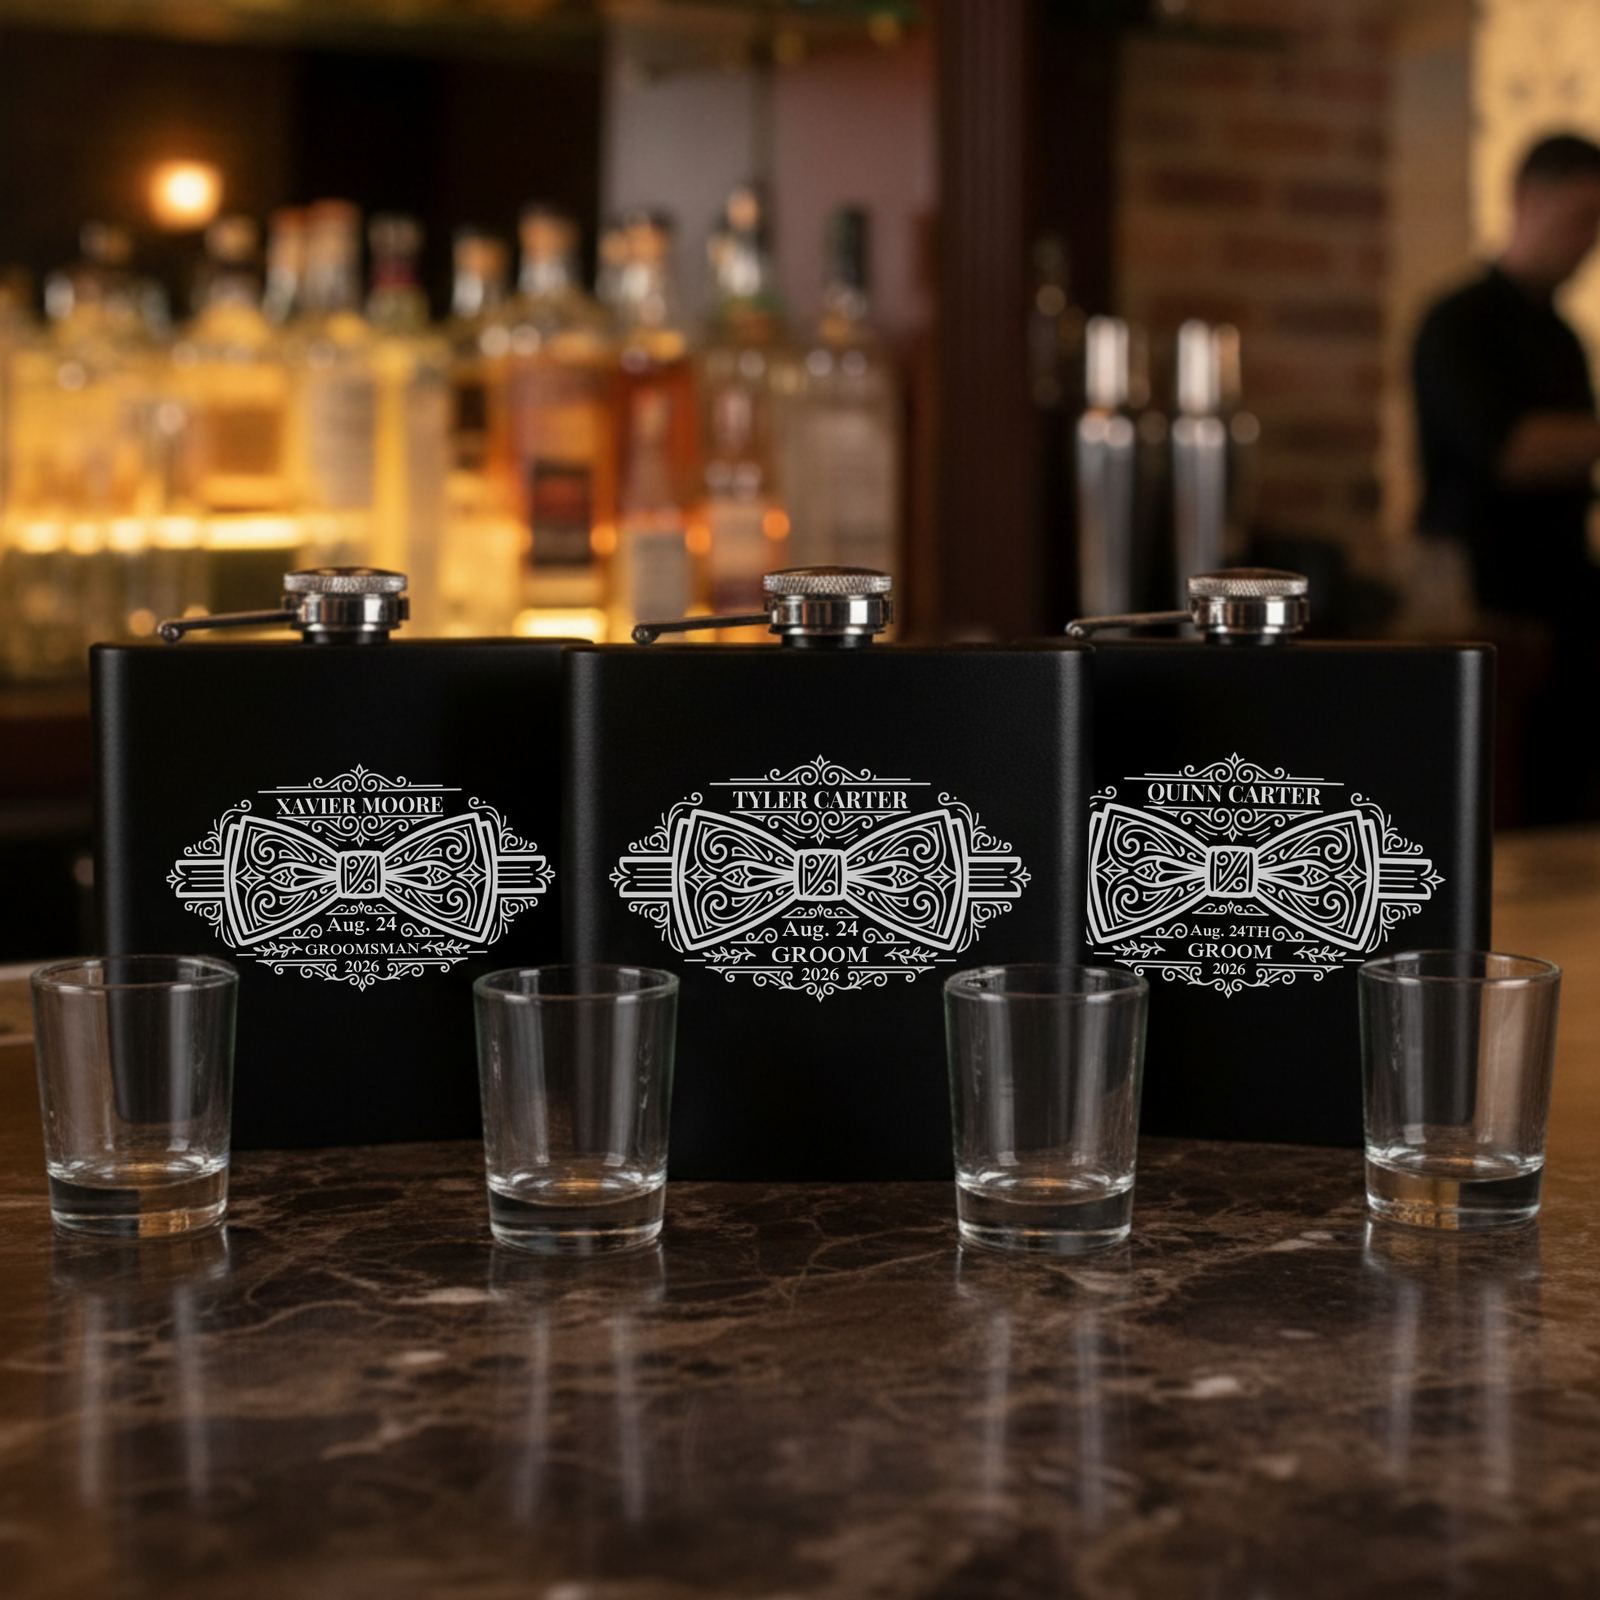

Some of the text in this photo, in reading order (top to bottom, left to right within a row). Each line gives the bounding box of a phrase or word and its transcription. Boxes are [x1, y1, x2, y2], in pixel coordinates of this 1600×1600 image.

[732, 790, 909, 809] TYLER CARTER
[1147, 782, 1321, 806] QUINN CARTER
[276, 795, 444, 815] XAVIER MOORE
[326, 916, 397, 936] Aug. 24
[782, 921, 859, 941] Aug. 24
[1189, 924, 1271, 939] Aug. 24TH
[305, 942, 420, 956] GROOMSMAN
[771, 946, 870, 964] GROOM
[1187, 943, 1273, 960] GROOM
[344, 959, 380, 974] 2026
[801, 967, 840, 982] 2026
[1212, 962, 1246, 976] 2026
